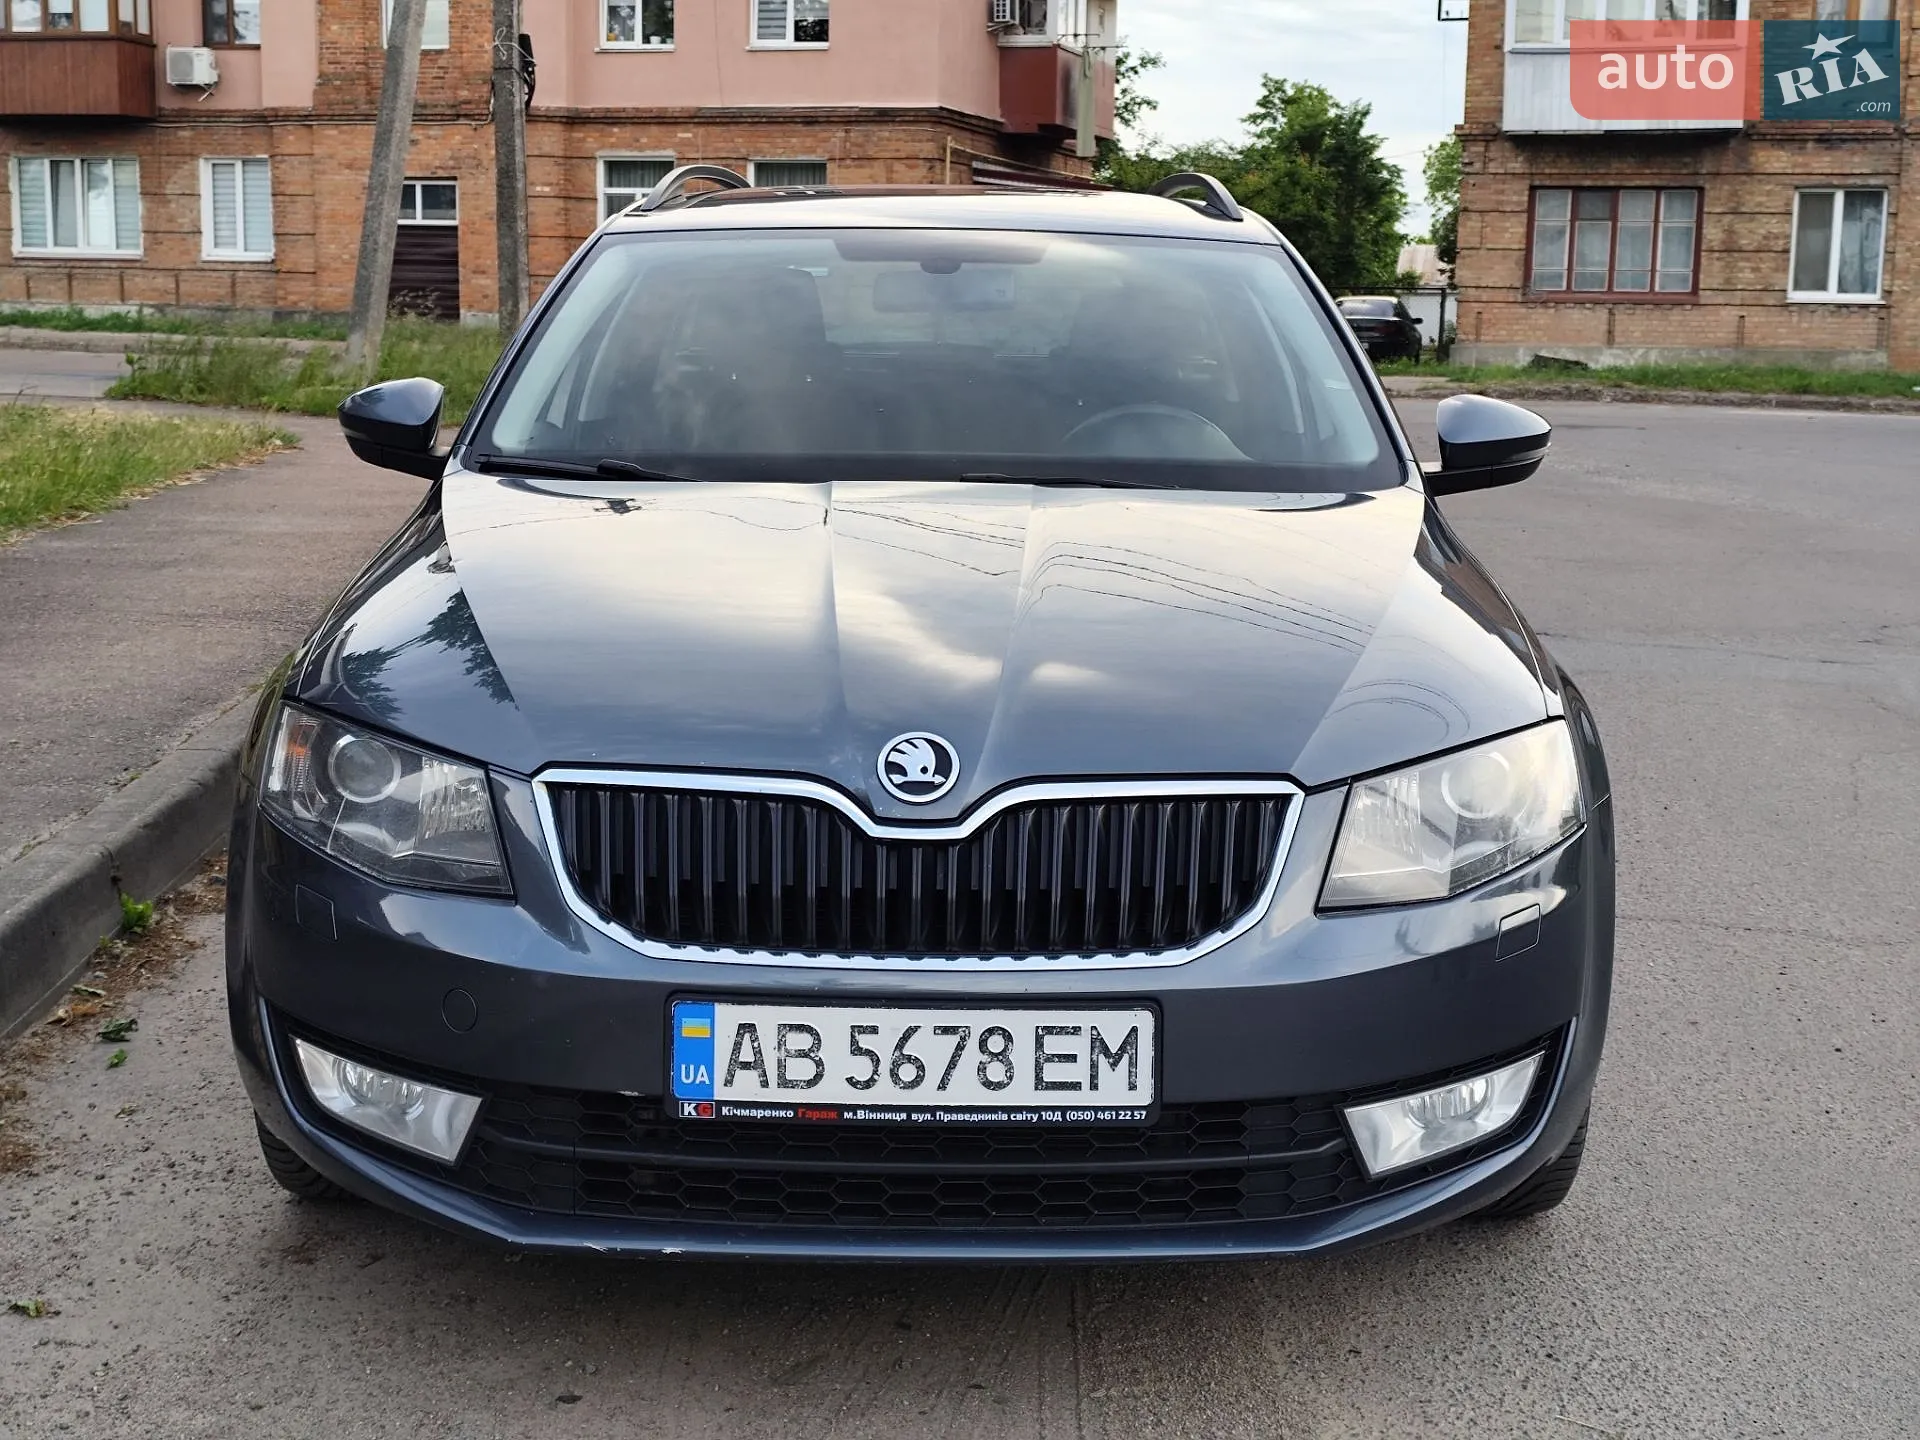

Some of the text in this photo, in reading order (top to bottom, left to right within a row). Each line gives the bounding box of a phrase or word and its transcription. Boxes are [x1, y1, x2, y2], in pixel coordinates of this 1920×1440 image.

[723, 1022, 1139, 1092] AB 5678 EM
[680, 1063, 711, 1085] UA
[721, 1106, 795, 1119] Кічмаренко
[797, 1108, 838, 1120] Гараж
[911, 1111, 934, 1123] вул.
[936, 1110, 1008, 1123] Праведників
[1010, 1110, 1039, 1123] світу
[1041, 1111, 1062, 1122] 10Д
[1066, 1110, 1096, 1122] (050)
[1097, 1111, 1116, 1120] 461
[1118, 1111, 1132, 1120] 22
[1133, 1110, 1147, 1120] 57
